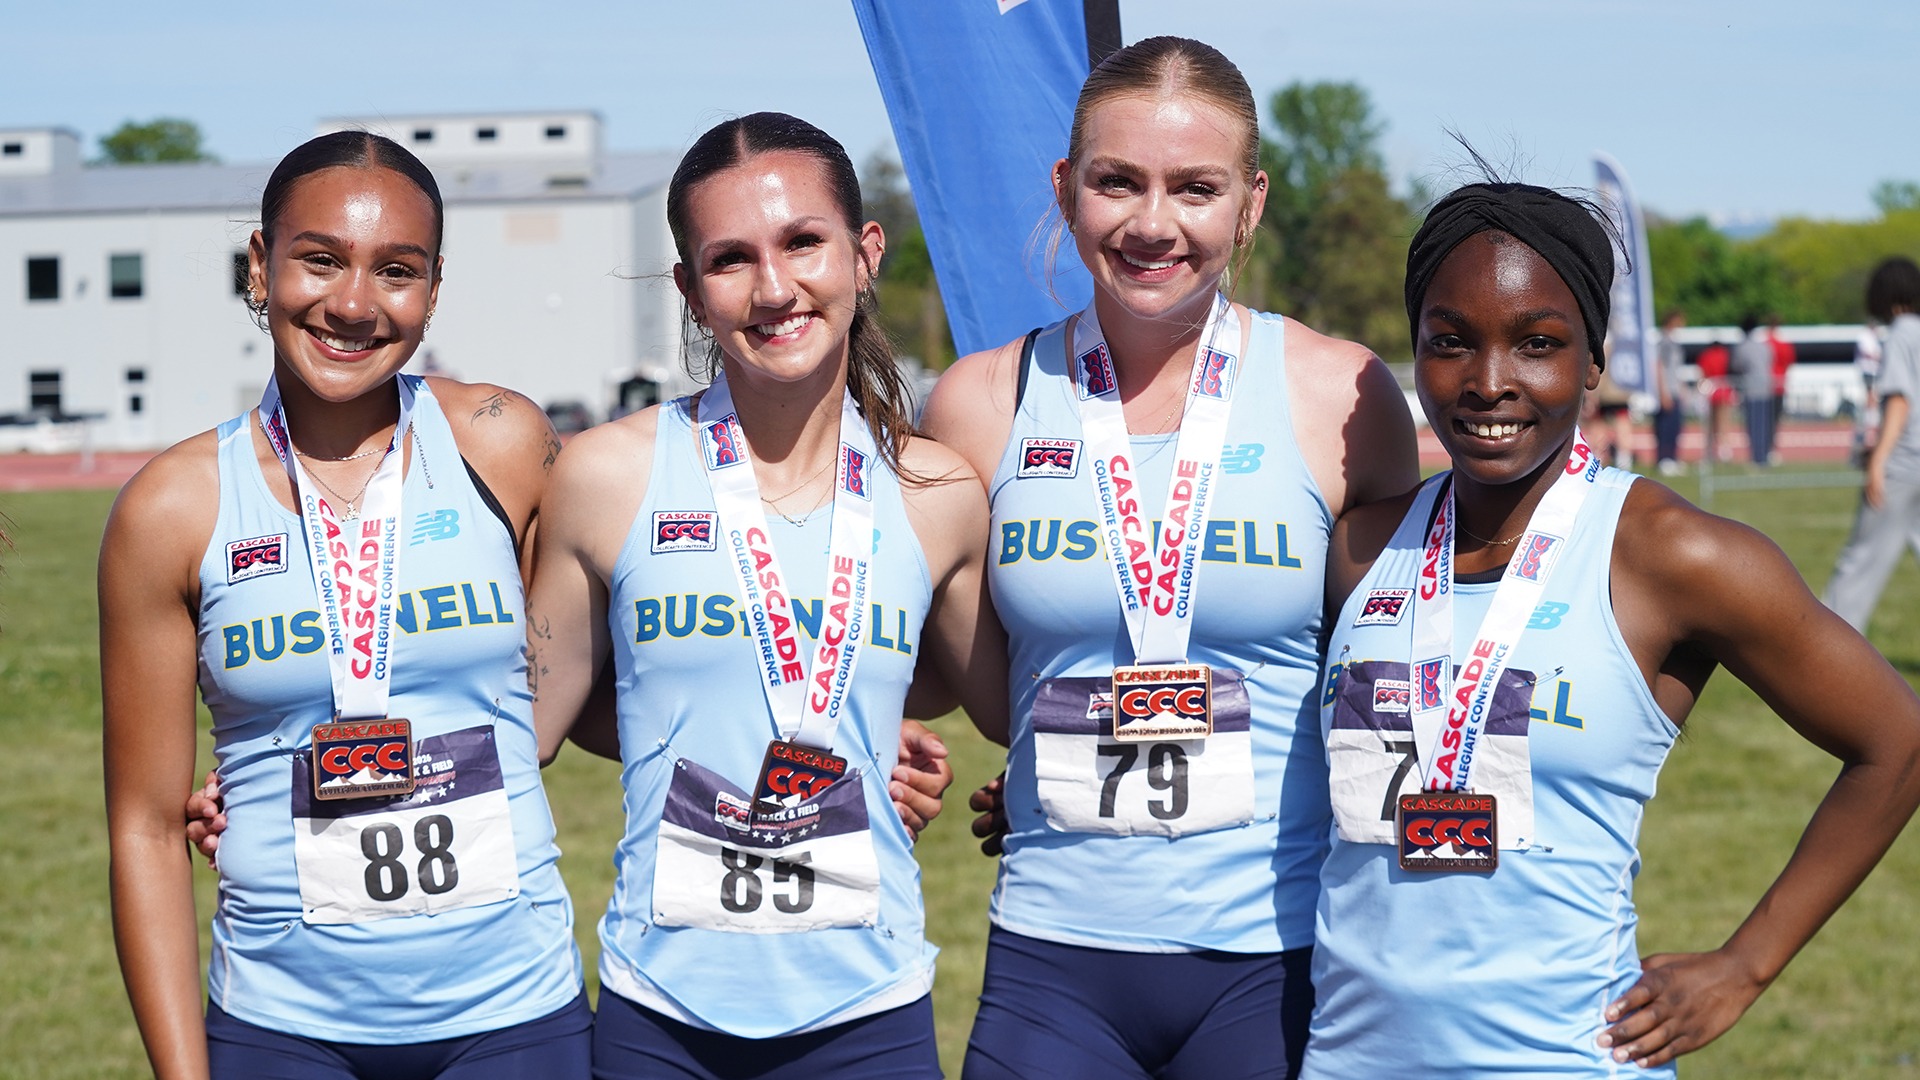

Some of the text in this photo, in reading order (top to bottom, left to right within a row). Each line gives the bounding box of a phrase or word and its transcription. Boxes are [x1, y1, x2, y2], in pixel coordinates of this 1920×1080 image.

[1099, 345, 1114, 390] CASCADE
[728, 415, 746, 461] CASCADE
[1026, 440, 1076, 448] CASCADE
[1027, 450, 1073, 465] CCC
[658, 513, 712, 521] CASCADE
[660, 523, 710, 539] CCC
[1094, 460, 1138, 611] COLLEGIATE CONFERENCE
[1153, 460, 1198, 617] CASCADE
[230, 536, 282, 550] CASCADE
[233, 546, 280, 567] CCC
[1175, 462, 1213, 619] COLLEGIATE CONFERENCE
[1440, 529, 1452, 595] COLLEGIATE
[1521, 536, 1550, 577] CCC
[305, 494, 344, 655] COLLEGIATE CONFERENCE
[351, 519, 381, 680] CASCADE
[375, 516, 396, 681] COLLEGIATE CONFERENCE
[730, 530, 782, 687] COLLEGIATE CONFERENCE
[746, 527, 804, 684] CASCADE
[1366, 599, 1403, 613] CCC
[223, 582, 515, 670] BUSNELL
[811, 556, 853, 714] CASCADE
[828, 644, 855, 719] COLLEGIATE
[848, 560, 867, 641] CONFERENCE
[1120, 687, 1206, 718] CCC
[1470, 643, 1509, 723] CONFERENCE
[316, 722, 407, 741] CASCADE
[321, 742, 408, 775] CCC
[773, 745, 845, 773] CASCADE
[1097, 743, 1189, 820] 79
[797, 803, 820, 816] FIELD
[1402, 799, 1492, 811] CASCADE
[1405, 818, 1492, 847] CCC
[360, 814, 460, 903] 88
[720, 847, 815, 914] 85
